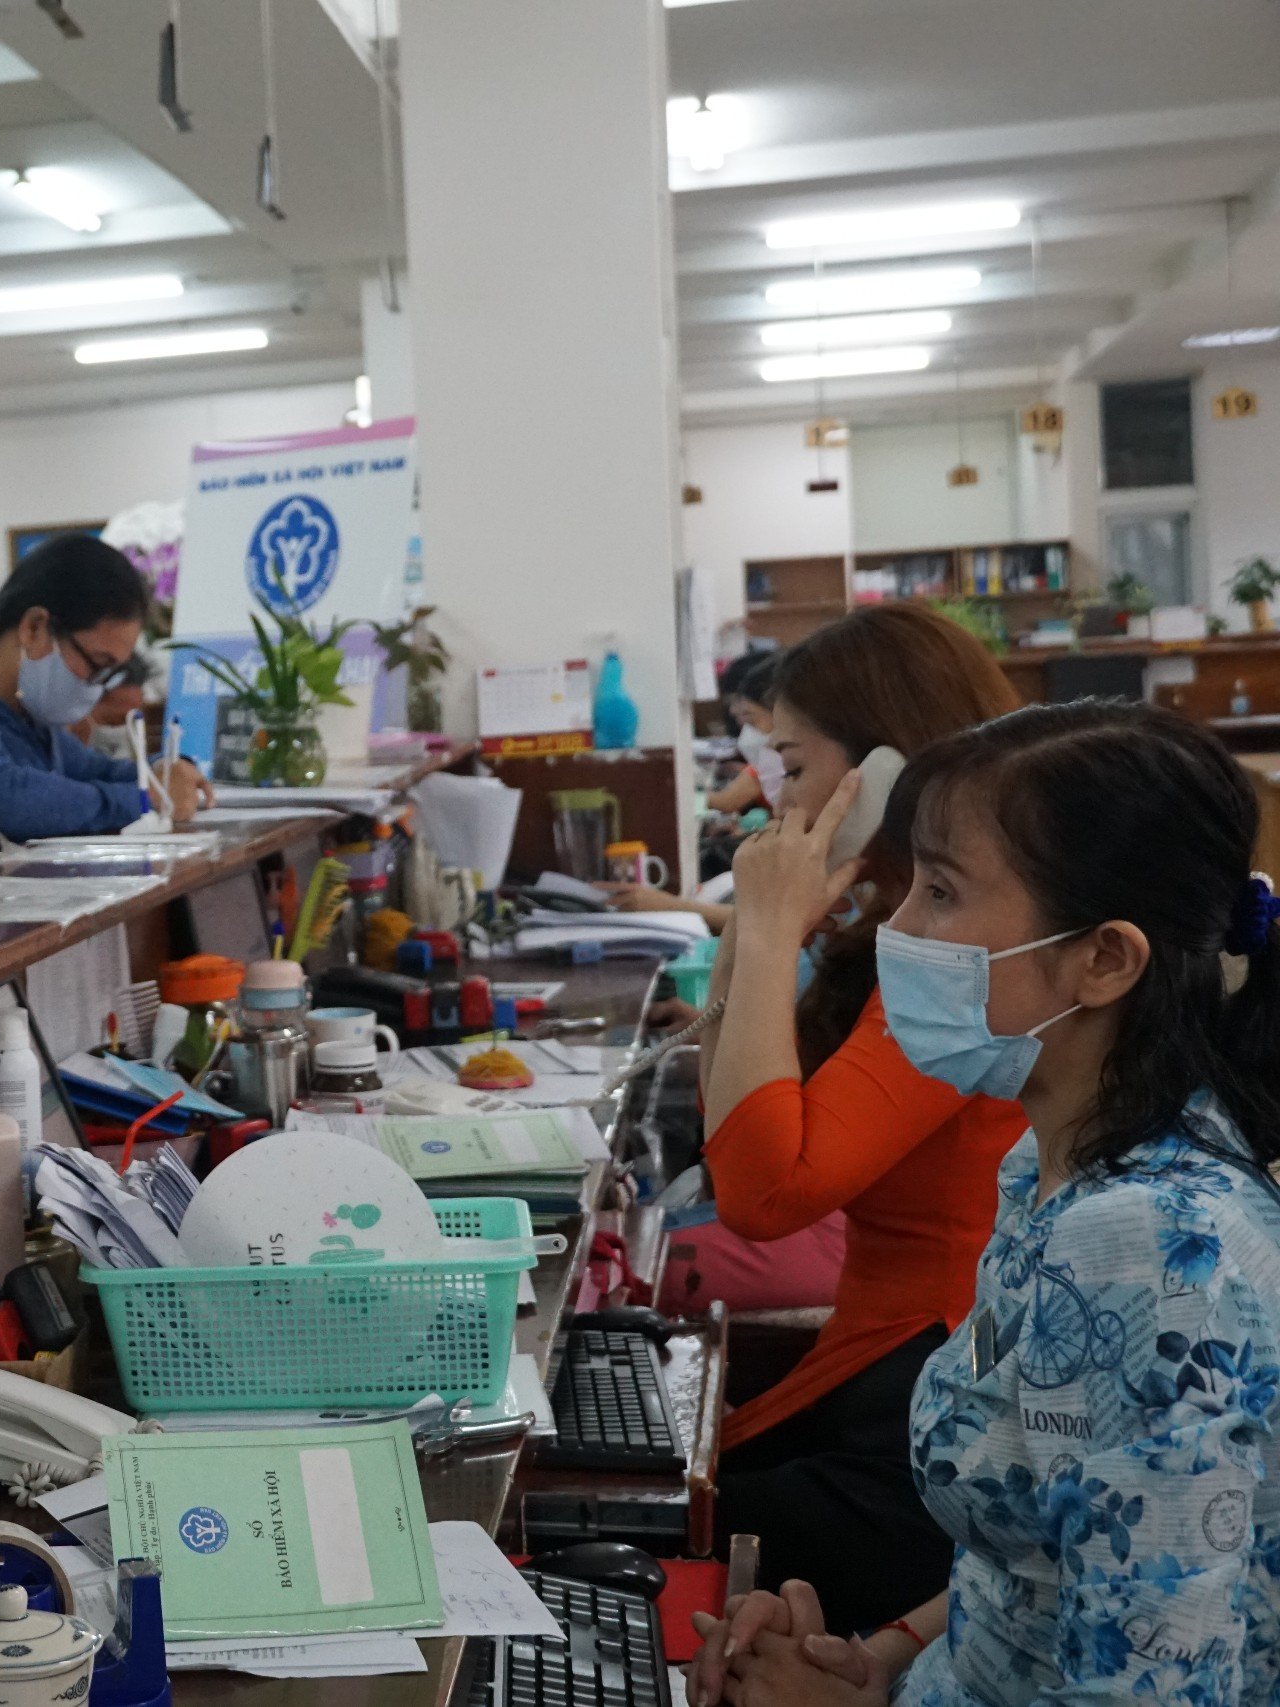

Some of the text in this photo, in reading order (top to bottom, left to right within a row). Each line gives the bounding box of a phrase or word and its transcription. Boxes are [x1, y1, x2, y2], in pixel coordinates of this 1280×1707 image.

[1217, 393, 1252, 416] 19
[1023, 1408, 1093, 1440] LONDON
[132, 1456, 140, 1473] NAM
[246, 1520, 264, 1539] SỔ
[263, 1470, 293, 1588] BẢO HIỂM XÃ HỘI
